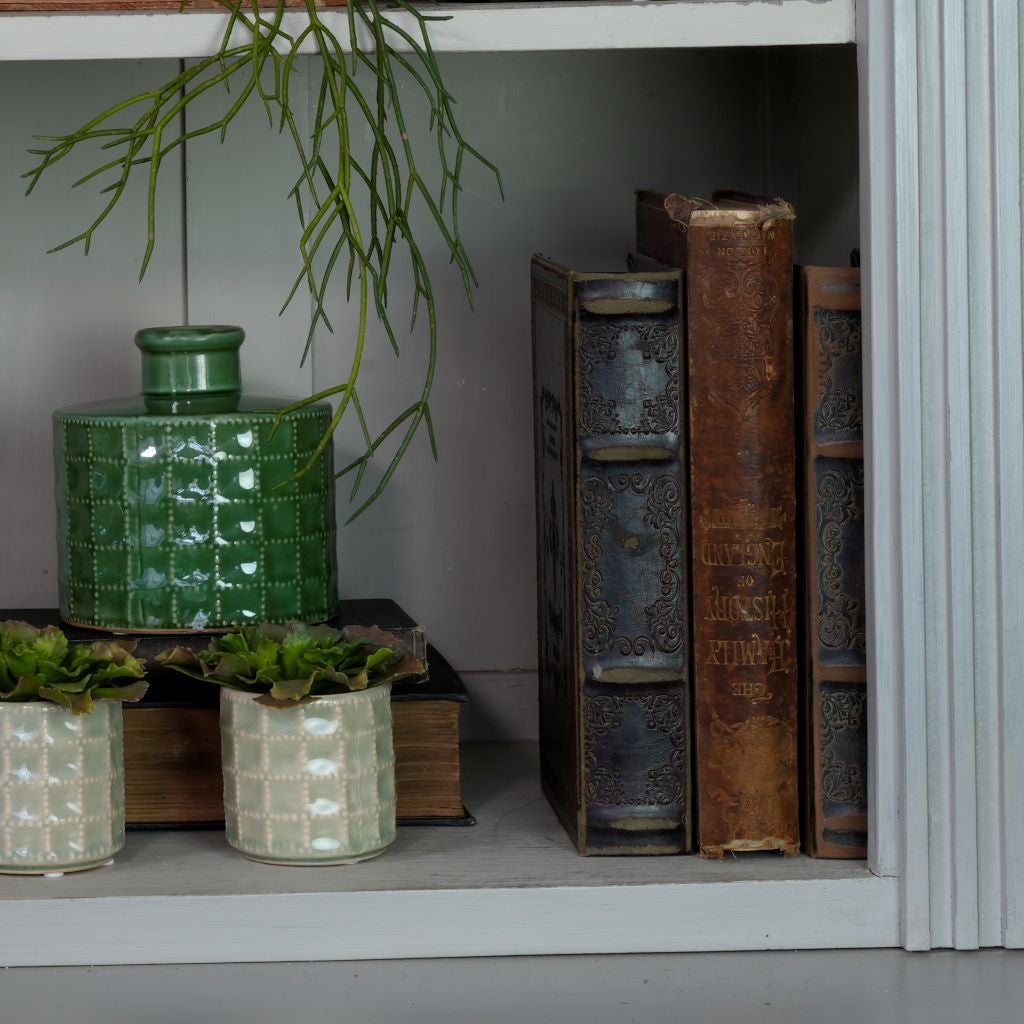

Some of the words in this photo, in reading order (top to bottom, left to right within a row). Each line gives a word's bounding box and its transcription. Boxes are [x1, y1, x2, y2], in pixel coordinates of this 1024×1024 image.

[701, 538, 787, 576] ENGLAND
[735, 575, 755, 587] OF
[703, 586, 791, 633] HISTORY
[704, 633, 791, 676] FAMILY
[731, 681, 773, 705] THE
